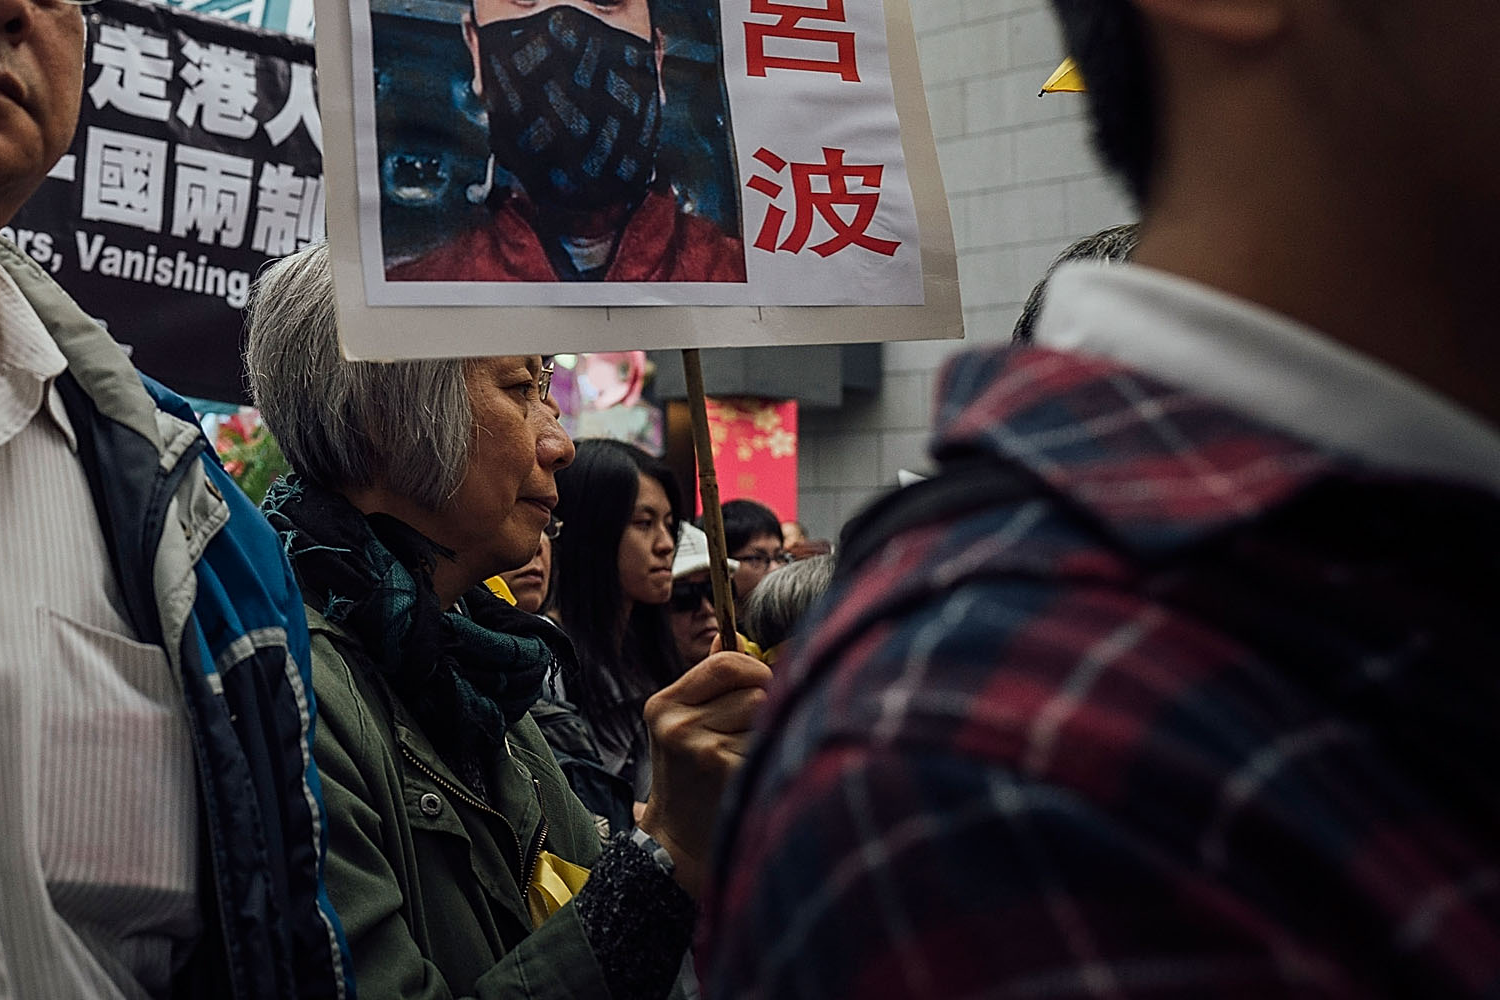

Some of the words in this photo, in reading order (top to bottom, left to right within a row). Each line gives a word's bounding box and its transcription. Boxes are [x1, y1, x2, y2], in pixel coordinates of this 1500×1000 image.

[88, 23, 324, 147] 走港人
[75, 230, 251, 309] Vanishing
